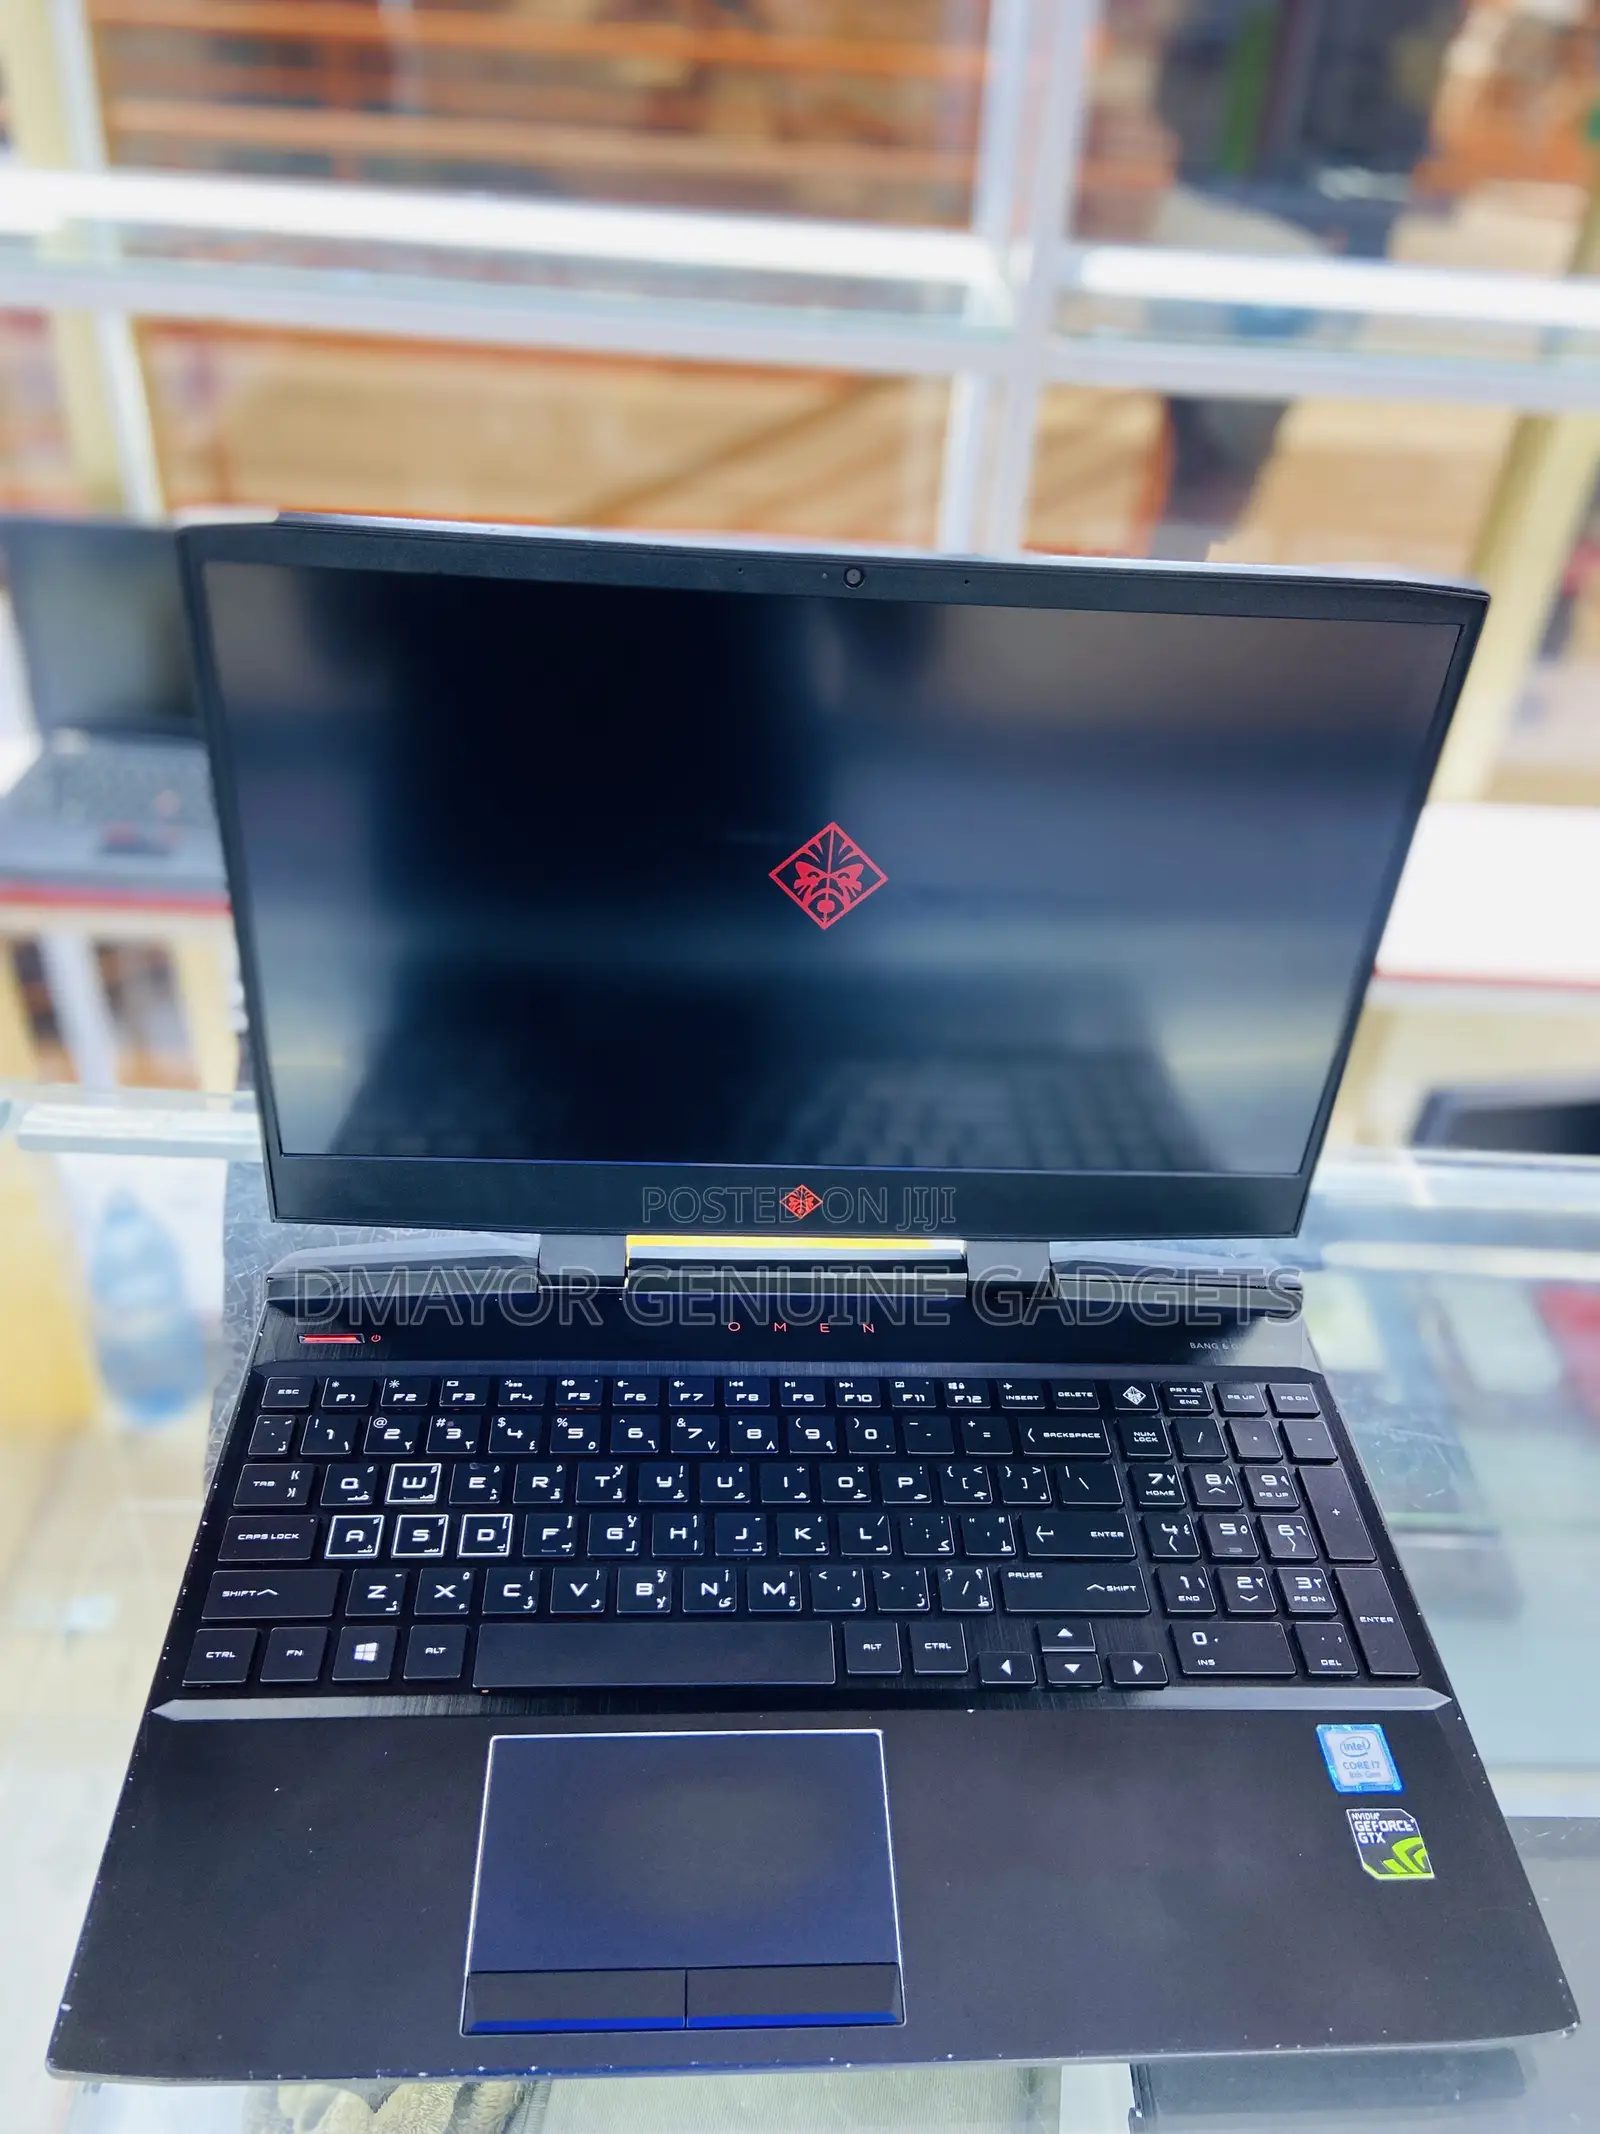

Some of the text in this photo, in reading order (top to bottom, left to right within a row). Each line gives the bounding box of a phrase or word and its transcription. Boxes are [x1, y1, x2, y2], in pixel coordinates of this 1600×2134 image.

[1190, 1342, 1219, 1350] BANG
[335, 1393, 356, 1402] F1
[392, 1393, 417, 1402] F2
[452, 1392, 476, 1401] F3
[509, 1393, 533, 1401] F4
[567, 1392, 591, 1401] F5
[624, 1393, 647, 1402] F6
[679, 1393, 704, 1402] F7
[736, 1393, 759, 1402] F8
[792, 1393, 815, 1402] F9
[844, 1394, 873, 1403] F10
[902, 1393, 926, 1402] F11
[954, 1395, 983, 1404] F12
[326, 1428, 335, 1440] 1
[383, 1428, 401, 1440] 2
[445, 1428, 462, 1440] 3
[506, 1427, 524, 1439] 4
[567, 1427, 584, 1439] 5
[627, 1427, 644, 1439] 6
[687, 1428, 703, 1439] 7
[746, 1428, 762, 1440] 8
[804, 1428, 821, 1440] 9
[340, 1477, 359, 1490] Q
[402, 1476, 427, 1489] W
[468, 1476, 487, 1489] E
[531, 1476, 549, 1488] R
[594, 1475, 611, 1488] T
[656, 1475, 673, 1488] Y
[716, 1476, 733, 1488] U
[897, 1476, 914, 1489] P
[1148, 1473, 1164, 1485] 7
[1204, 1473, 1222, 1486] 8
[1260, 1474, 1278, 1486] 9
[541, 1528, 560, 1541] F
[606, 1527, 624, 1540] G
[669, 1527, 687, 1540] H
[734, 1527, 748, 1540] J
[794, 1527, 812, 1540] K
[859, 1527, 873, 1540] L
[1160, 1523, 1179, 1535] 4
[1219, 1522, 1238, 1535] 5
[1277, 1524, 1295, 1539] 6
[237, 1532, 300, 1541] CAPS LOCK
[345, 1529, 365, 1543] A
[411, 1529, 430, 1542] S
[476, 1528, 495, 1542] D
[1007, 1571, 1044, 1579] PAUSE
[1179, 1575, 1190, 1589] 1
[1236, 1576, 1254, 1589] 2
[1295, 1576, 1313, 1590] 3
[221, 1590, 257, 1598] SHIFT
[367, 1585, 388, 1599] Z
[433, 1584, 457, 1599] X
[502, 1583, 522, 1598] C
[569, 1582, 589, 1597] V
[635, 1582, 654, 1596] B
[700, 1582, 719, 1596] N
[762, 1581, 786, 1596] M
[1359, 1616, 1394, 1624] ENTER
[1191, 1631, 1208, 1646] 0
[424, 1647, 447, 1655] ALT
[862, 1643, 882, 1651] ALT
[924, 1642, 952, 1650] CTRL
[205, 1651, 236, 1659] CTRL
[286, 1649, 303, 1657] FN
[1343, 1760, 1369, 1770] CORE
[1354, 1820, 1414, 1832] GEFORCE
[1357, 1832, 1386, 1844] GTX
